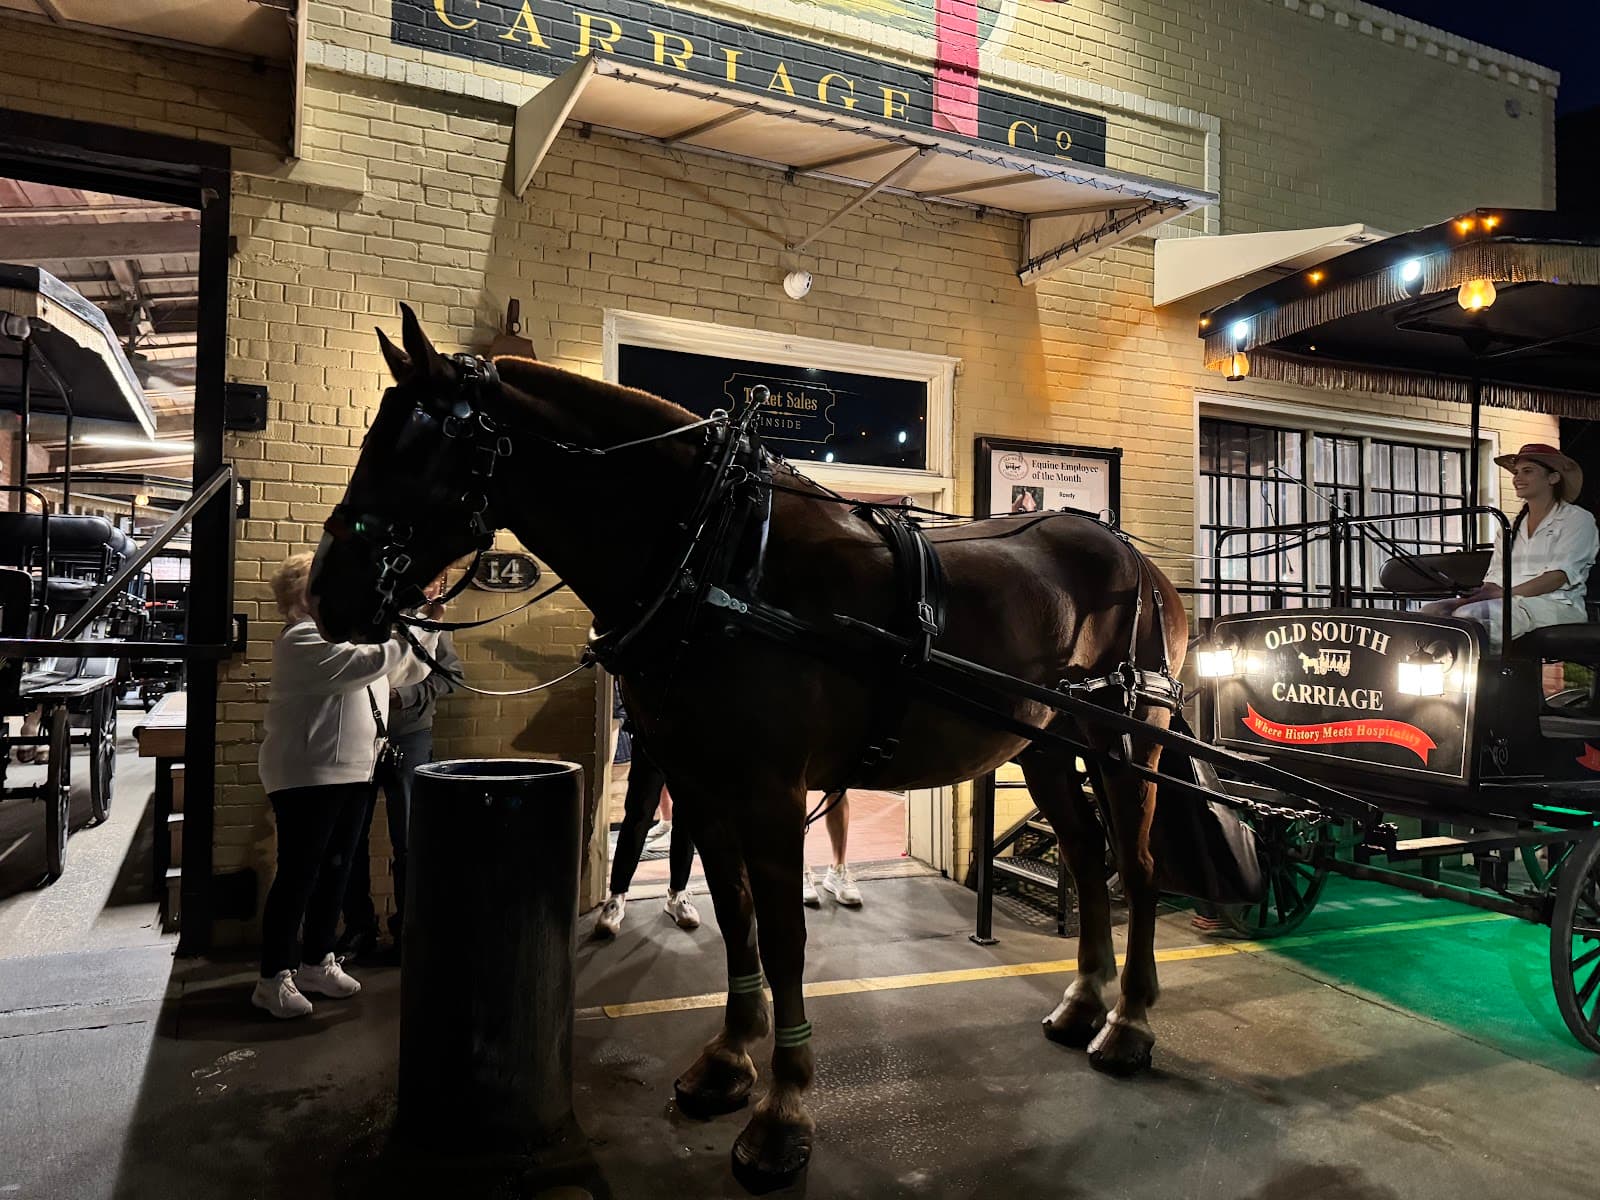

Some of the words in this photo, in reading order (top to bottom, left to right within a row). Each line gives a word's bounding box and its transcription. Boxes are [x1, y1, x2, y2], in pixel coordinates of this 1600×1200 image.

[433, 0, 912, 123] CARRIAGE
[786, 392, 818, 411] Sales
[760, 416, 801, 430] INSIDE
[1032, 460, 1060, 471] Equine
[1061, 462, 1099, 473] Employee
[1032, 471, 1041, 480] of
[1042, 471, 1055, 481] the
[1056, 473, 1082, 483] Month
[487, 559, 523, 584] 14
[1265, 623, 1307, 650] OLD
[1311, 621, 1391, 656] SOUTH
[1272, 682, 1384, 711] CARRIAGE
[1254, 717, 1282, 739] Where
[1285, 728, 1320, 740] History
[1322, 727, 1353, 739] Meets
[1356, 724, 1421, 745] Hospitality
